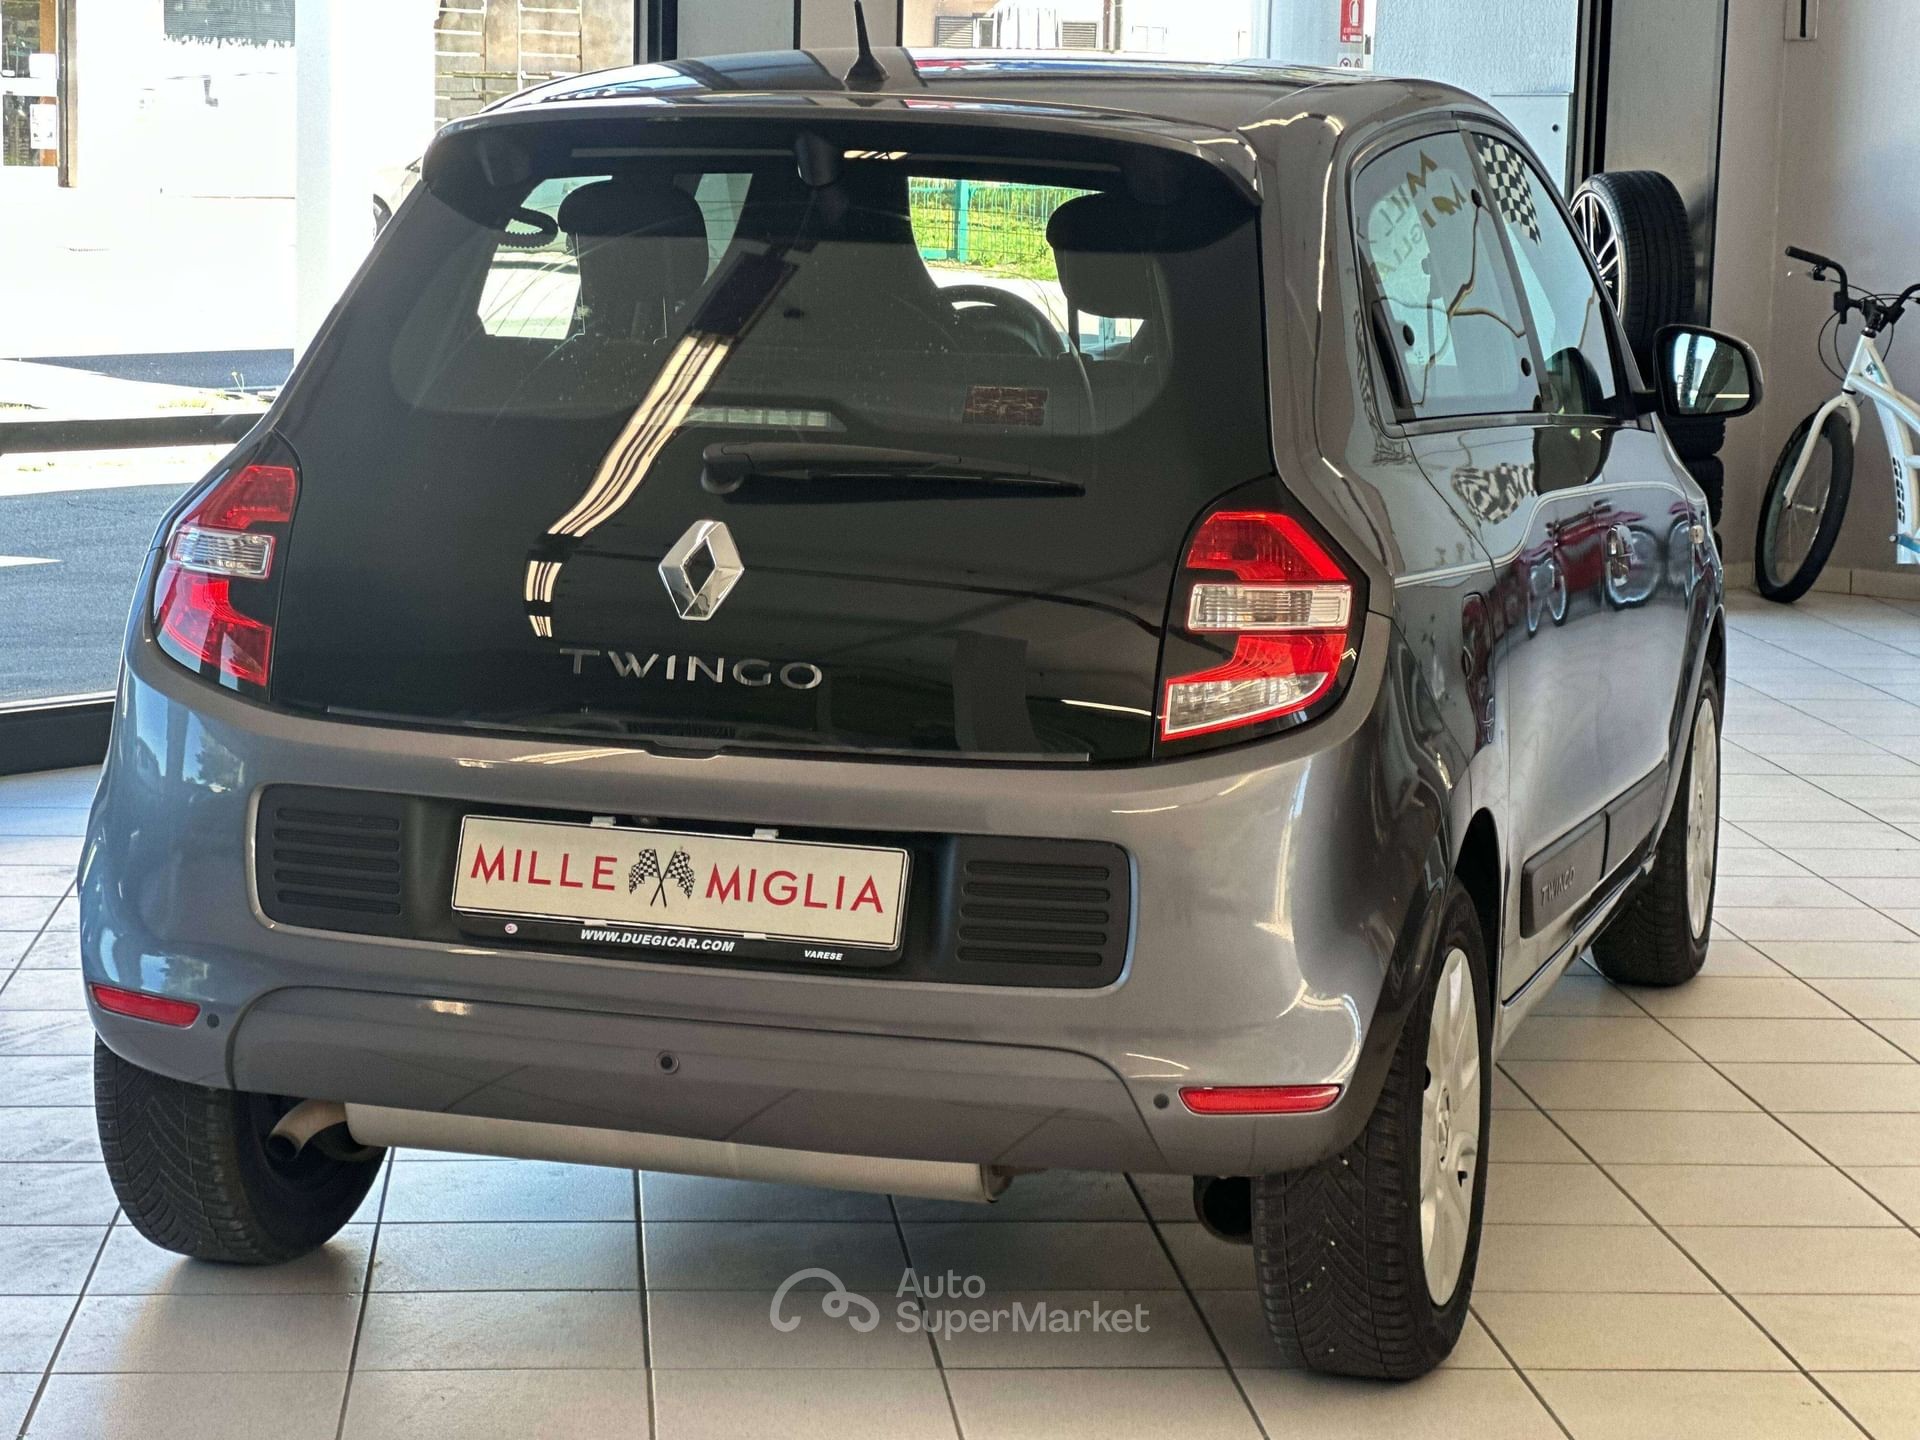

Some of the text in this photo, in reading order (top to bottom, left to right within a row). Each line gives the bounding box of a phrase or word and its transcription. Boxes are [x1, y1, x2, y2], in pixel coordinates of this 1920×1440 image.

[559, 648, 823, 690] TWINGO
[470, 844, 884, 914] MILLE MIGLIA
[580, 928, 736, 953] WWW.DUEGICAR.COM
[804, 949, 843, 961] VARESE
